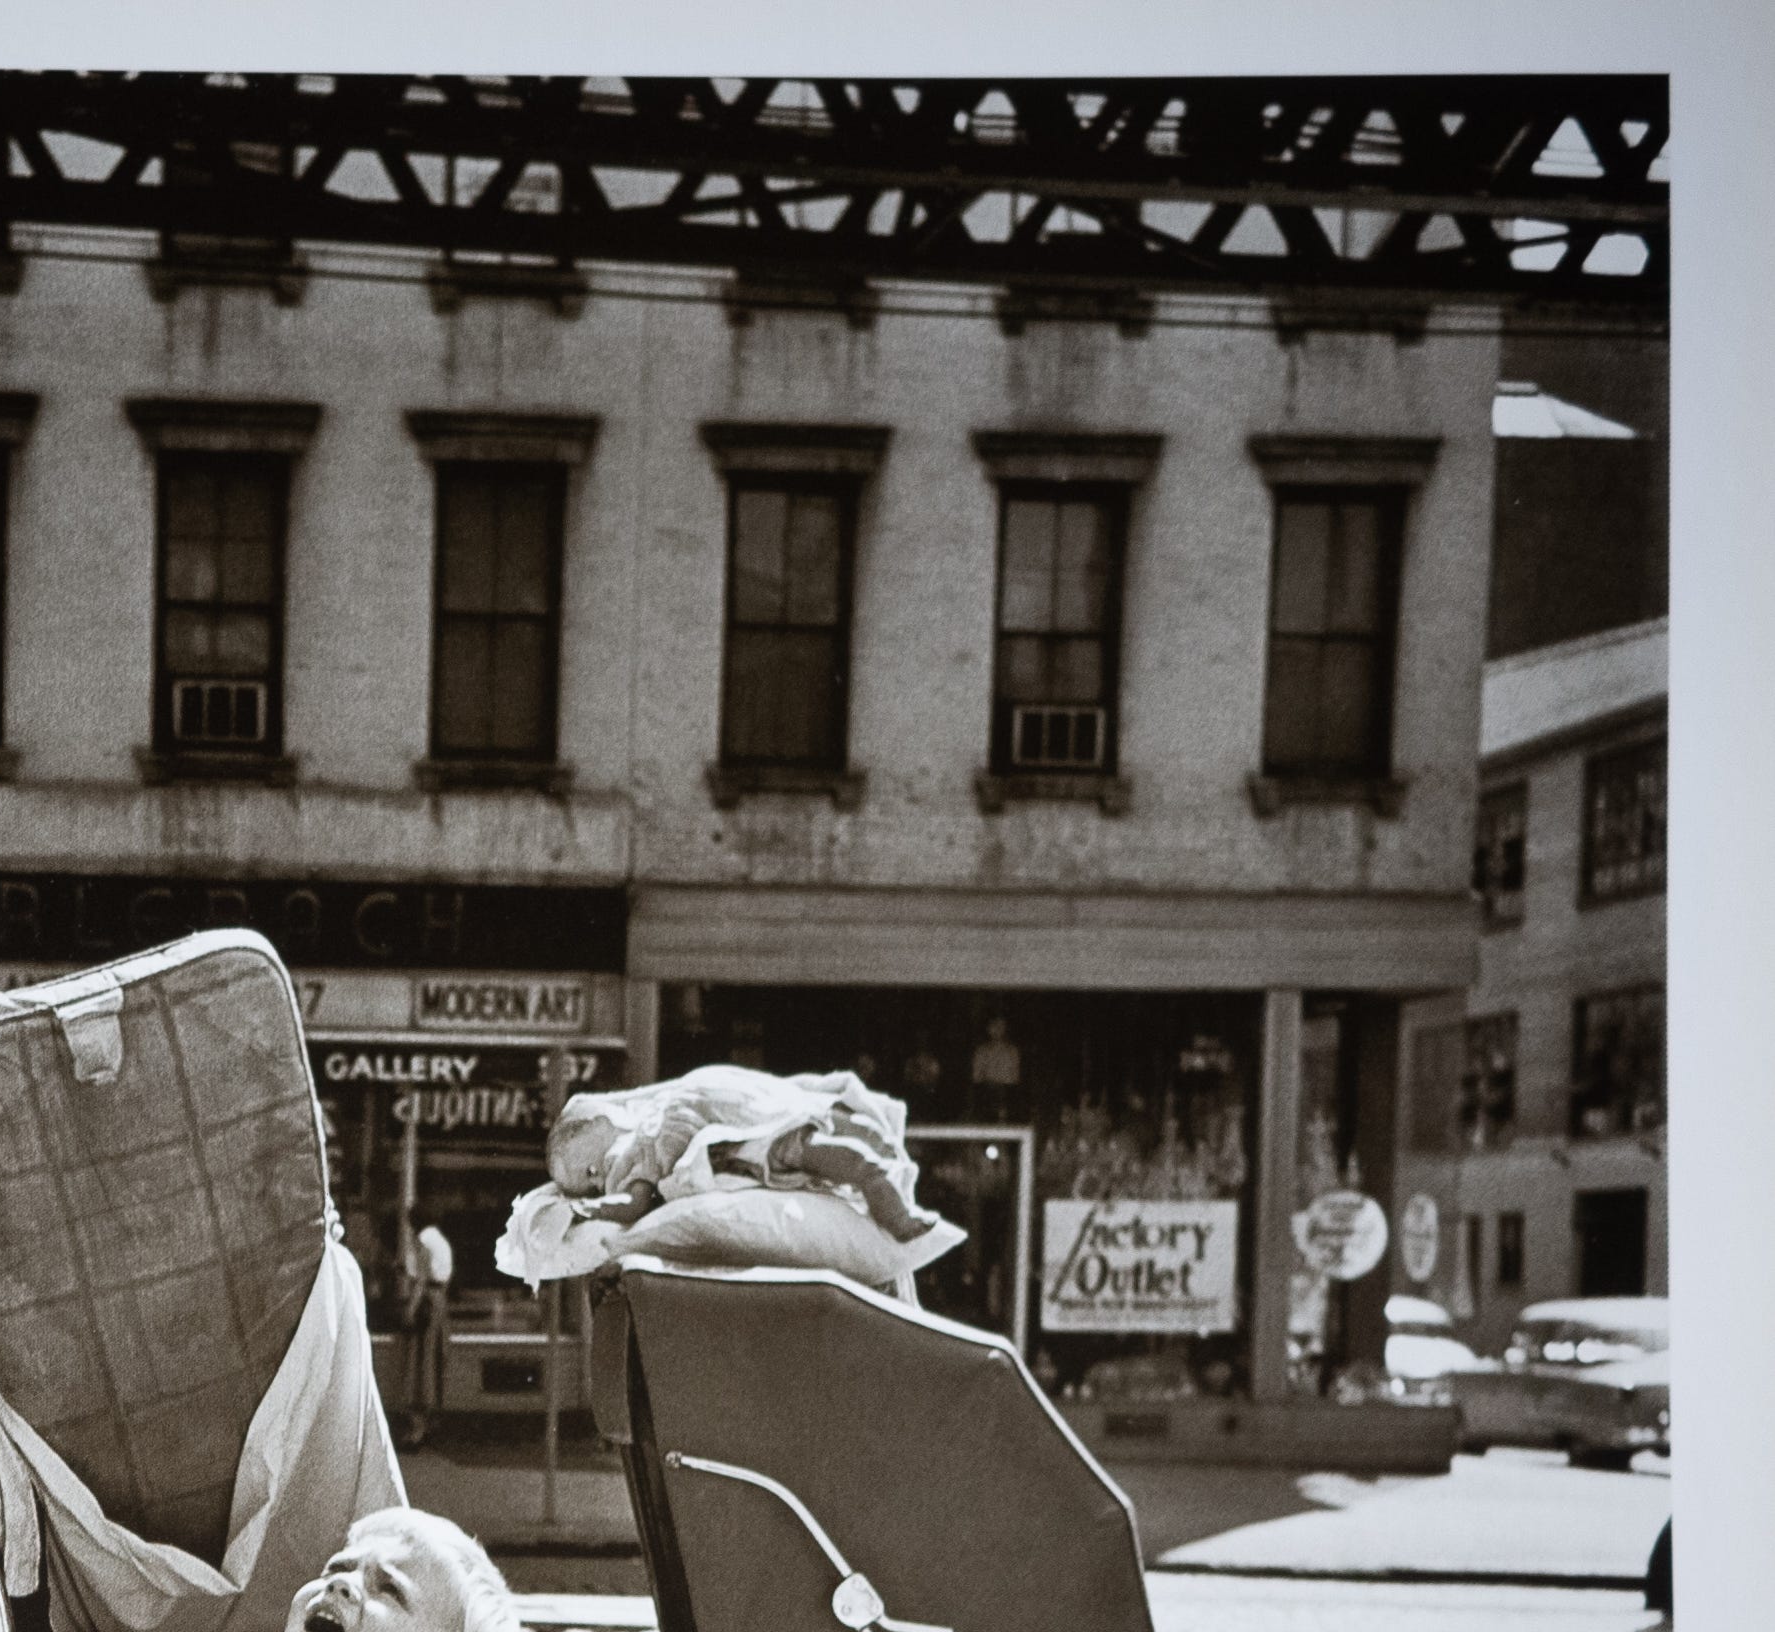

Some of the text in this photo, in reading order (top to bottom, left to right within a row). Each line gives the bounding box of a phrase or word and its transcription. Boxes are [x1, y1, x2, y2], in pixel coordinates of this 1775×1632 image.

[420, 982, 581, 1022] MODERN ART
[326, 1052, 478, 1082] GALLERY
[1076, 1253, 1193, 1297] Outlet
